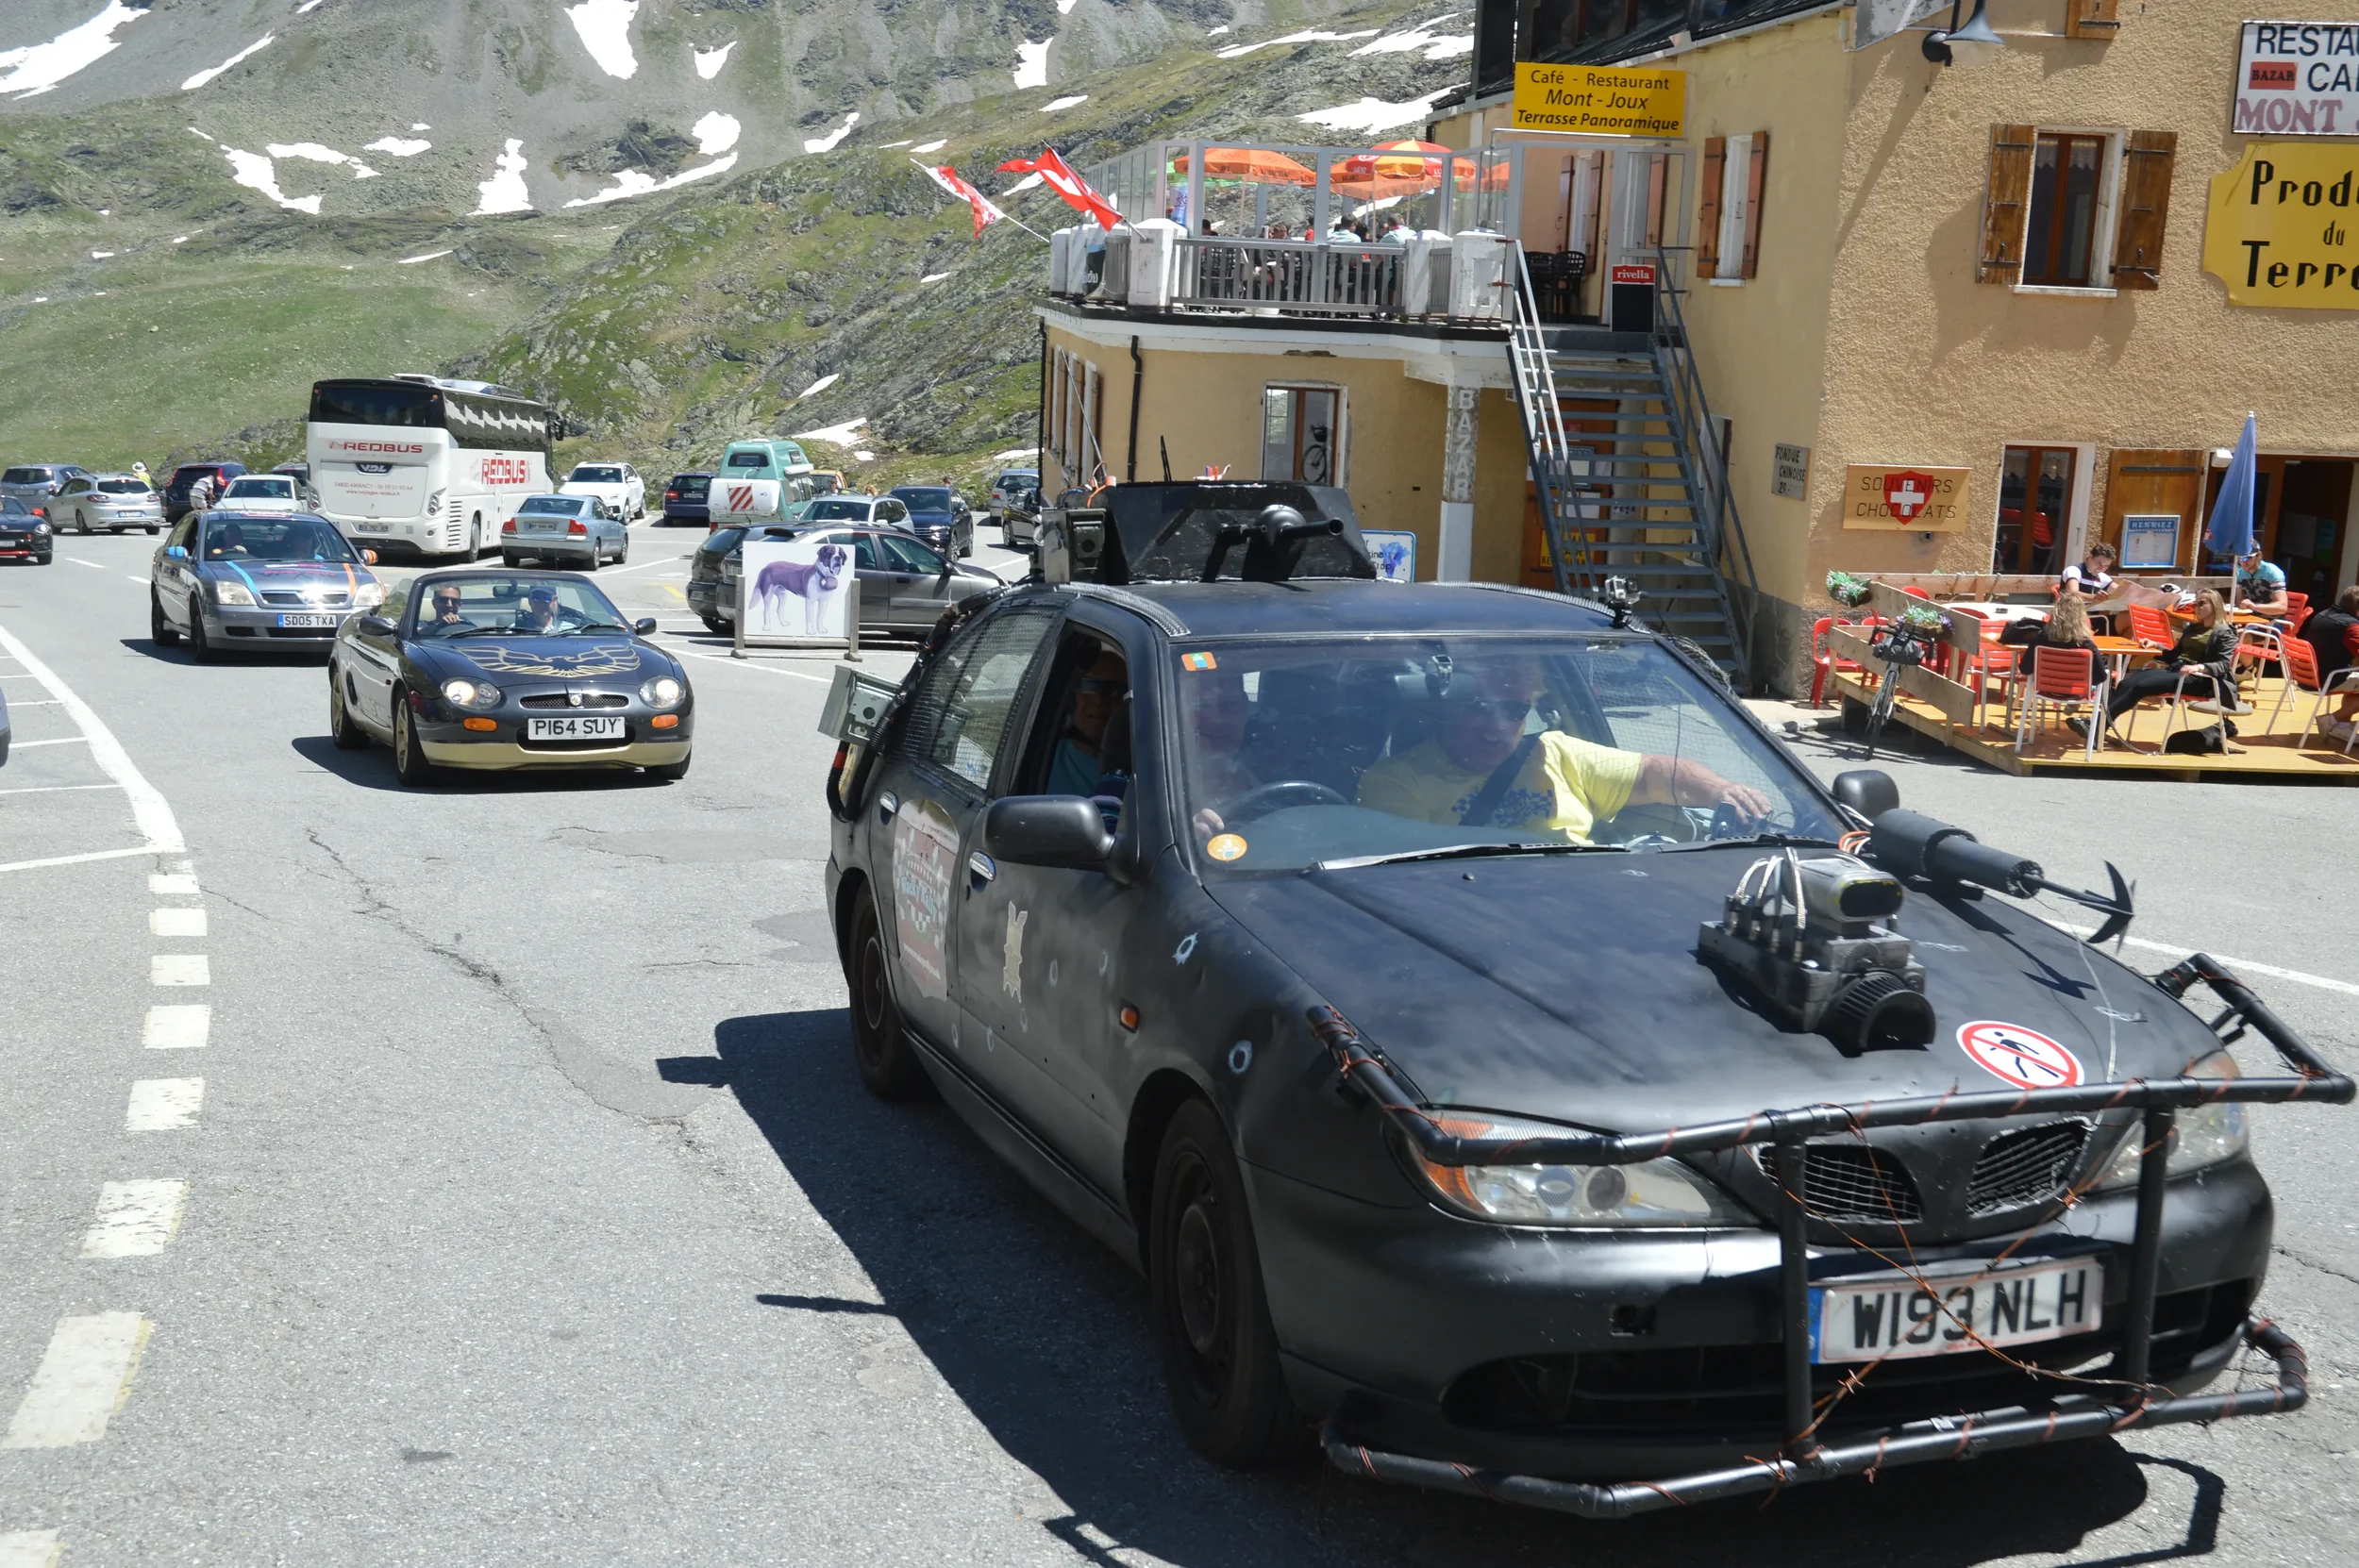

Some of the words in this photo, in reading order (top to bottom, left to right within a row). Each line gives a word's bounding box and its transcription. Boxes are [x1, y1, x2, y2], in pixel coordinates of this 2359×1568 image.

[2255, 25, 2359, 57] RESTA
[1531, 70, 1564, 85] Café
[1587, 73, 1669, 90] Restaurant
[2250, 69, 2296, 82] BAZAR
[2307, 62, 2359, 92] CA
[1546, 89, 1593, 107] Mont
[1606, 92, 1649, 109] Joux
[1517, 109, 1577, 125] Terrasse
[1581, 113, 1680, 133] Panoramique
[2235, 98, 2344, 132] MONT
[2250, 160, 2359, 207] Prod
[2323, 220, 2346, 246] du
[1616, 269, 1650, 280] rivella
[343, 442, 423, 453] REDBUS
[1454, 390, 1475, 501] BAZAR
[1776, 446, 1800, 463] FONDUE
[360, 464, 388, 473] VDL
[481, 459, 526, 485] REDBUS
[1780, 465, 1806, 482] CHINOISE
[1861, 476, 1953, 493] SOUVENIRS
[1856, 502, 1957, 519] CHOCOLATS
[284, 616, 312, 626] SD05
[315, 615, 335, 626] TXA
[534, 720, 577, 736] P164
[582, 718, 618, 735] SUY
[1853, 1285, 1975, 1349] W193
[1991, 1270, 2086, 1336] NLH
